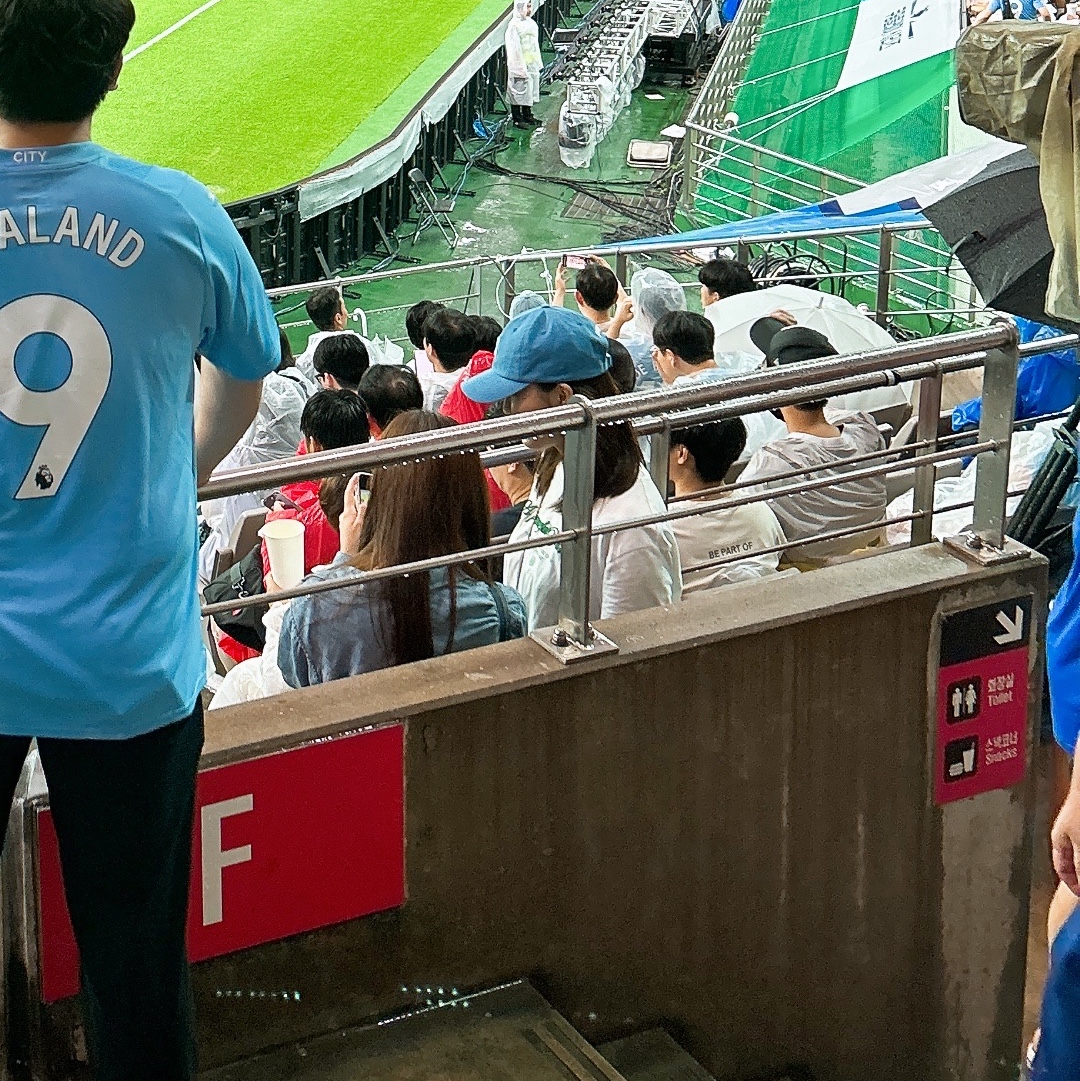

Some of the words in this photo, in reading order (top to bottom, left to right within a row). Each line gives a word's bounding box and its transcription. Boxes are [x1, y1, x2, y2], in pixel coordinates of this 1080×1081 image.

[13, 150, 47, 163] CITY
[708, 549, 720, 559] BE
[721, 544, 741, 557] PART
[742, 541, 754, 552] OF
[200, 793, 254, 927] F
